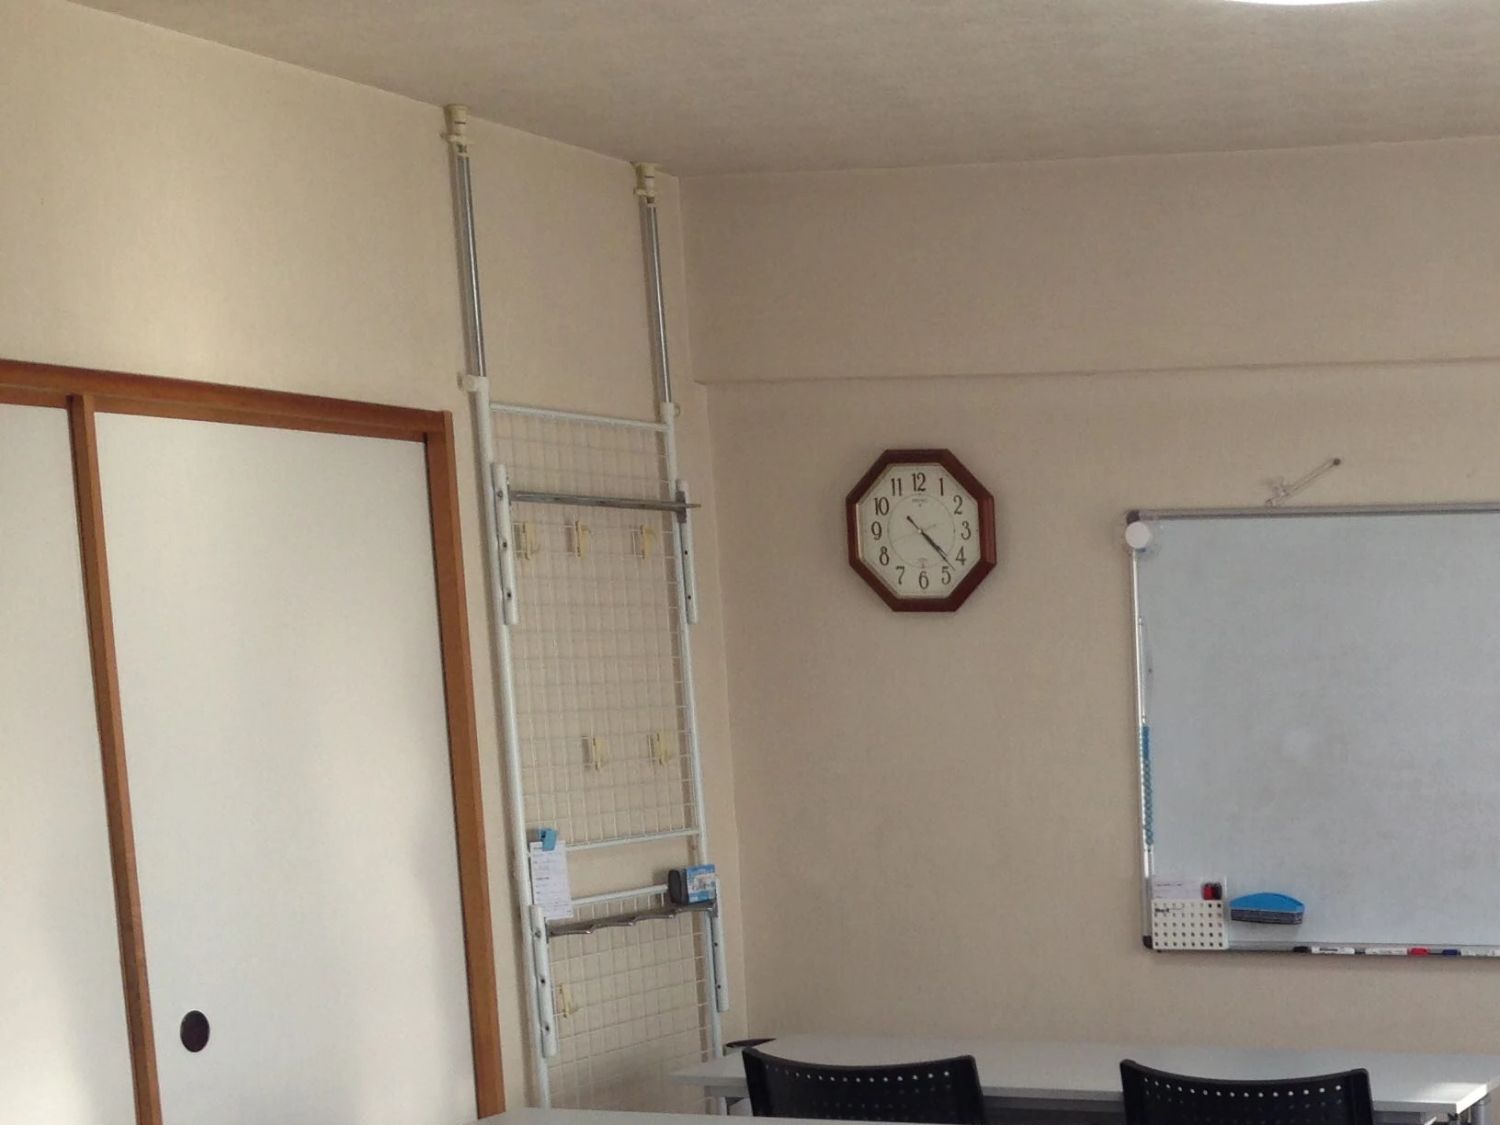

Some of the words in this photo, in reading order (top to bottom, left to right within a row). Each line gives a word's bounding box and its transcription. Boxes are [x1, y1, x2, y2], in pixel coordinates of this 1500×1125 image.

[891, 477, 903, 497] 11
[912, 472, 926, 492] 12
[939, 477, 945, 497] 1
[874, 496, 890, 516] 10
[953, 495, 963, 515] 2
[871, 521, 882, 541] 9
[961, 521, 971, 540] 3
[879, 546, 889, 566] 8
[956, 545, 966, 566] 4
[896, 566, 905, 585] 7
[918, 570, 929, 590] 6
[941, 566, 951, 585] 5
